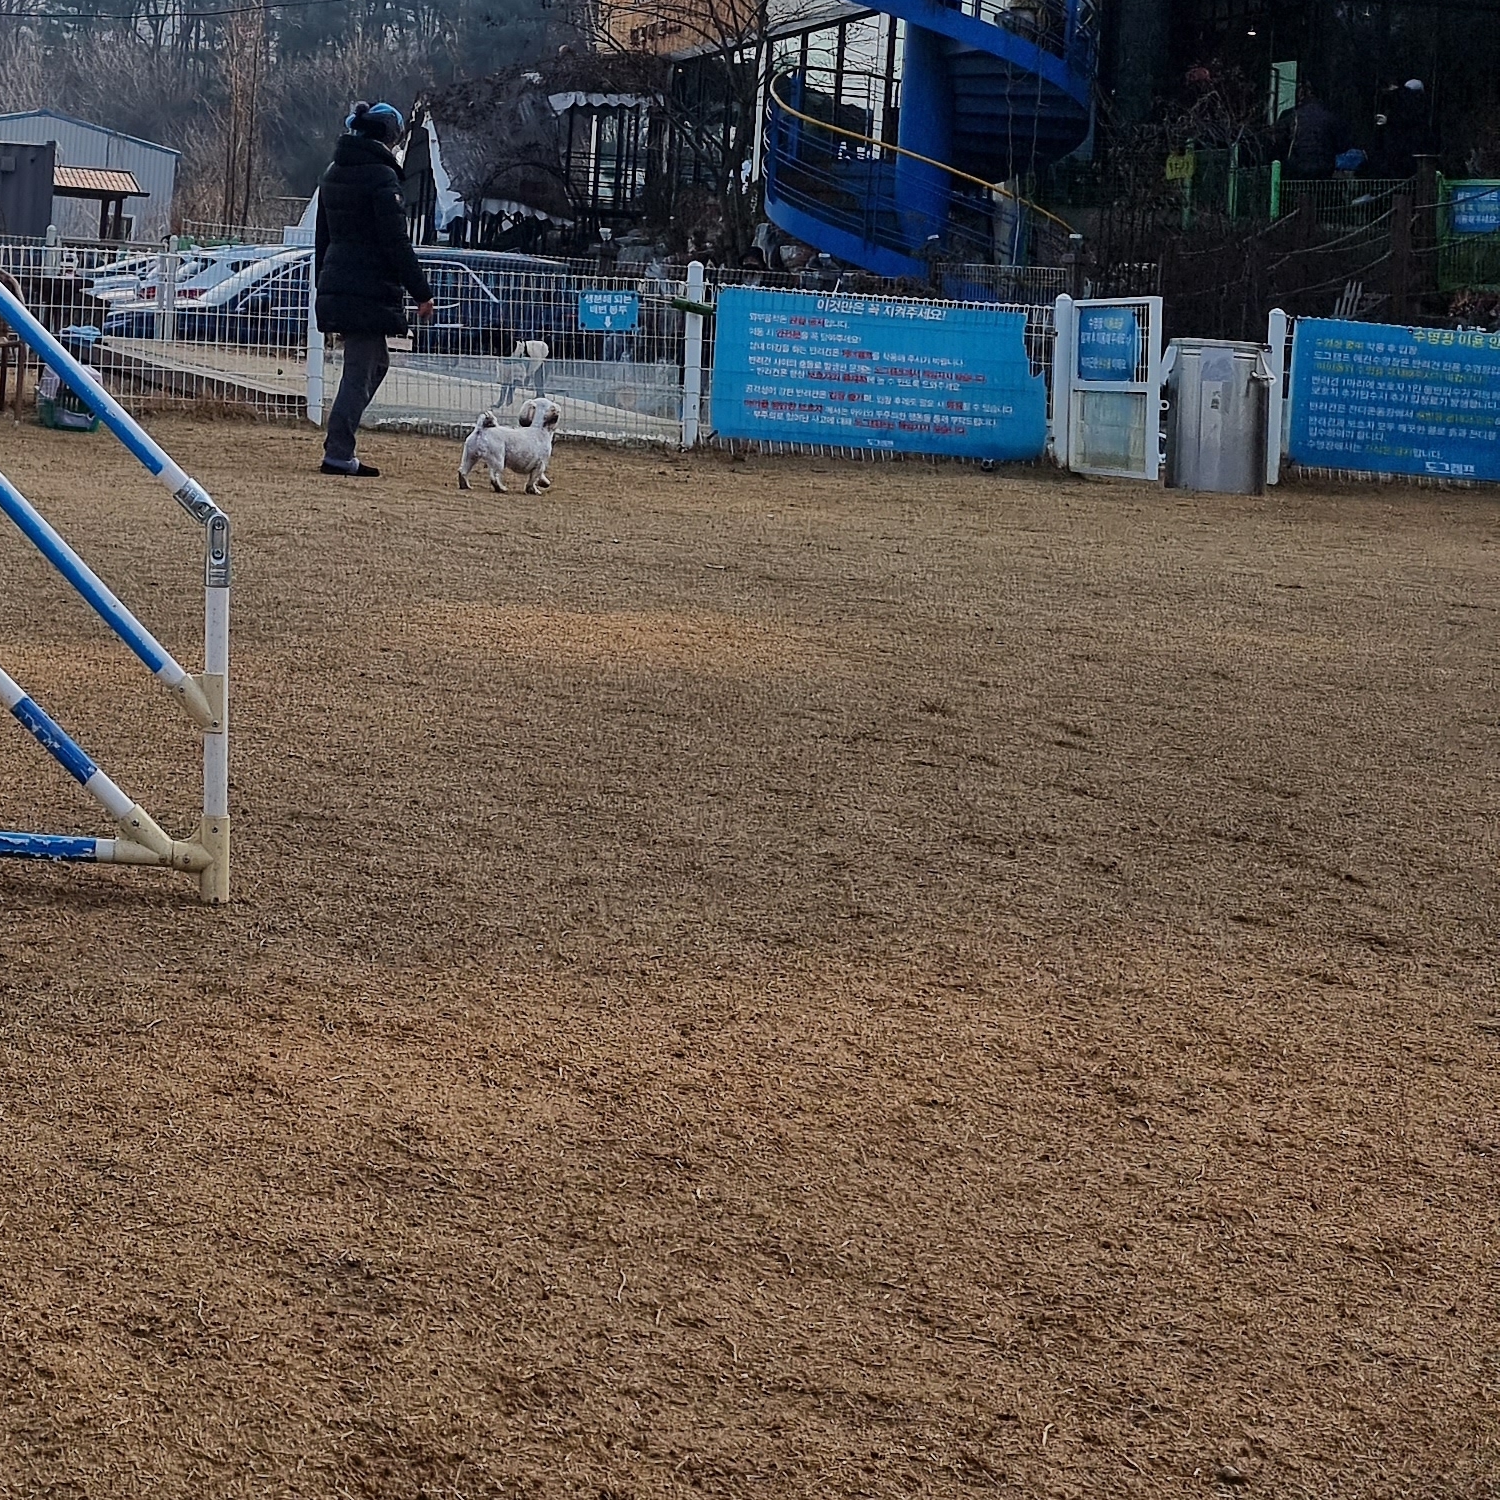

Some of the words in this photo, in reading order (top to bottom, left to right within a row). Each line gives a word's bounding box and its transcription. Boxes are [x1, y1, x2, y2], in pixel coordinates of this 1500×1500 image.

[613, 295, 632, 304] 되는
[816, 299, 864, 315] 이것만은
[868, 304, 880, 316] 꼭
[884, 305, 947, 321] 지켜주세요!
[1413, 330, 1454, 346] 수영장
[1458, 334, 1485, 348] 이용
[792, 345, 807, 354] 하는
[809, 347, 840, 357] 반려견은
[1399, 345, 1418, 355] 입장
[748, 356, 771, 365] 반려견
[774, 357, 797, 368] 사이의
[1412, 359, 1440, 370] 반려견
[756, 366, 788, 377] 반려견은
[1311, 376, 1339, 387] 반려견
[1342, 378, 1375, 389] 1마리에
[1408, 384, 1421, 394] 1인
[746, 384, 777, 395] 공격성이
[796, 388, 827, 399] 반려견은
[1309, 401, 1346, 413] 반려견은
[753, 410, 785, 421] 부주의로
[1306, 439, 1362, 453] 수영장에서는
